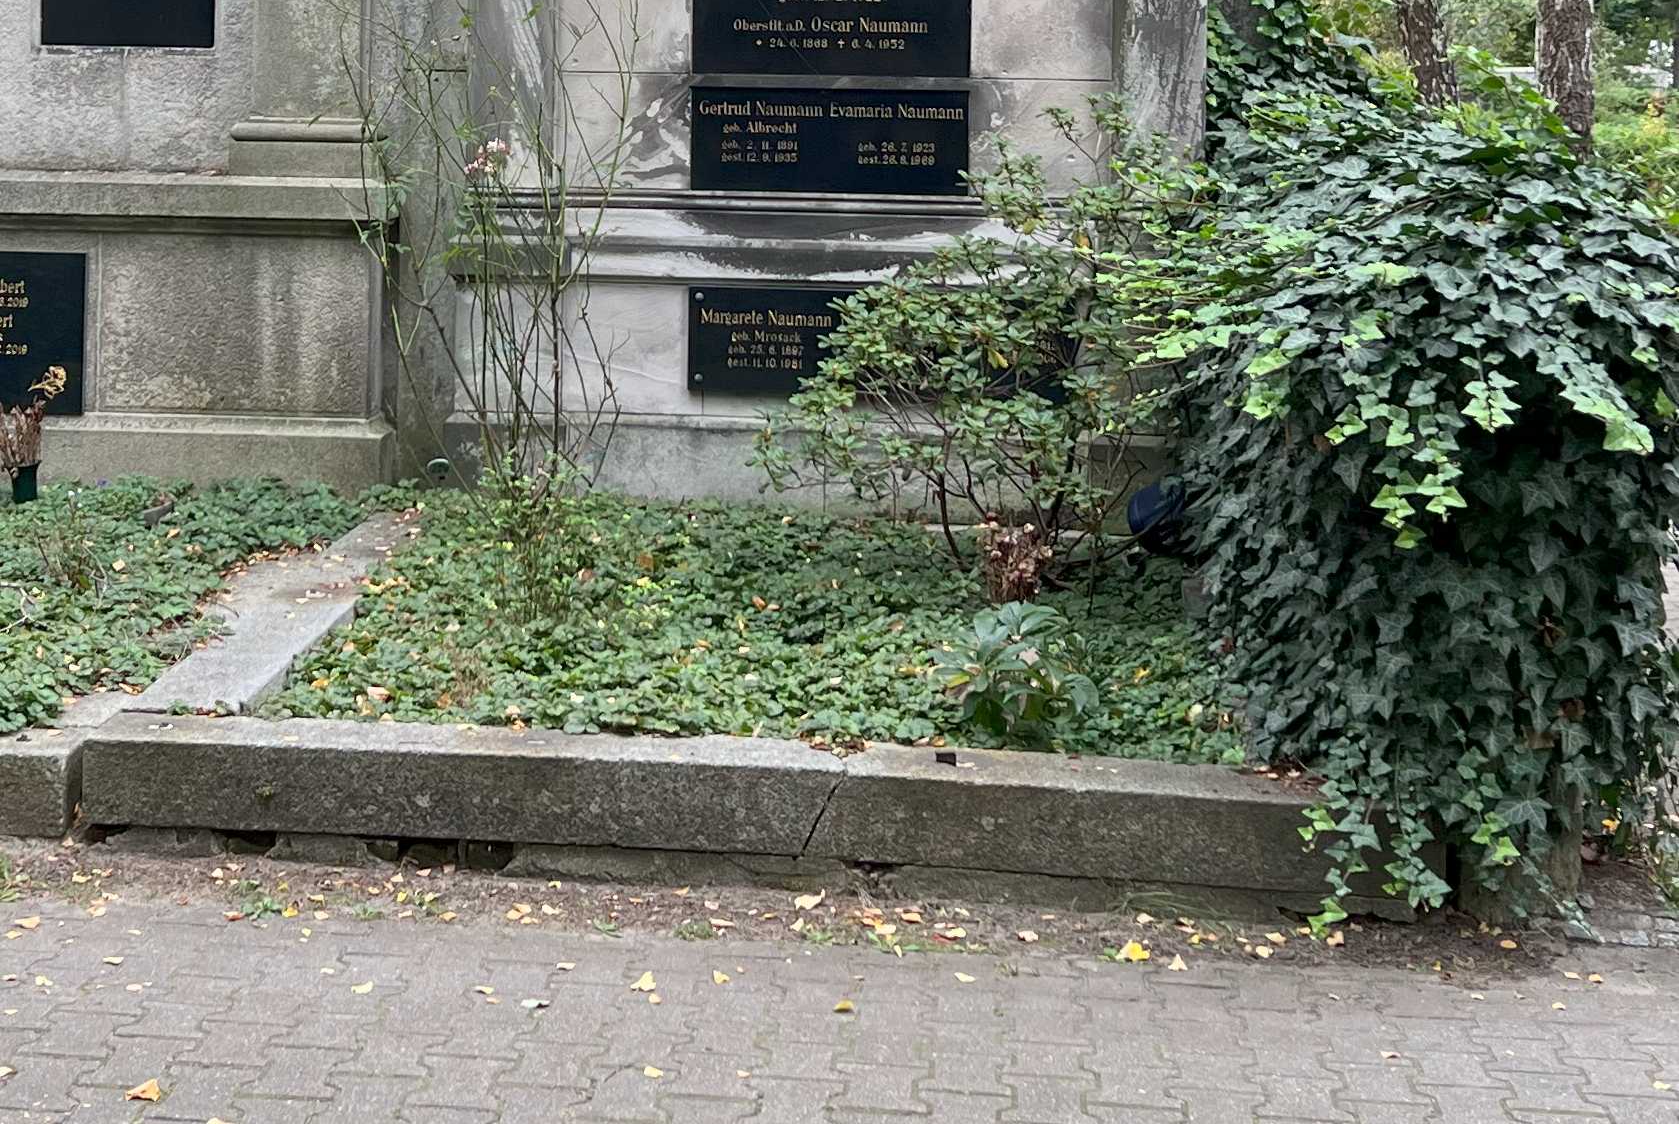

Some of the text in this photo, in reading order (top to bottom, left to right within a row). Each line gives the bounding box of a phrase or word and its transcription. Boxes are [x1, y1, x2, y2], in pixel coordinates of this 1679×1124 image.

[811, 16, 854, 33] Oscar
[860, 17, 928, 34] Naumann
[699, 100, 824, 117] Gertrud Naumann
[830, 101, 964, 121] Evamaria Naumann
[746, 120, 798, 134] Albrecht
[700, 307, 832, 328] Margarete Naumann
